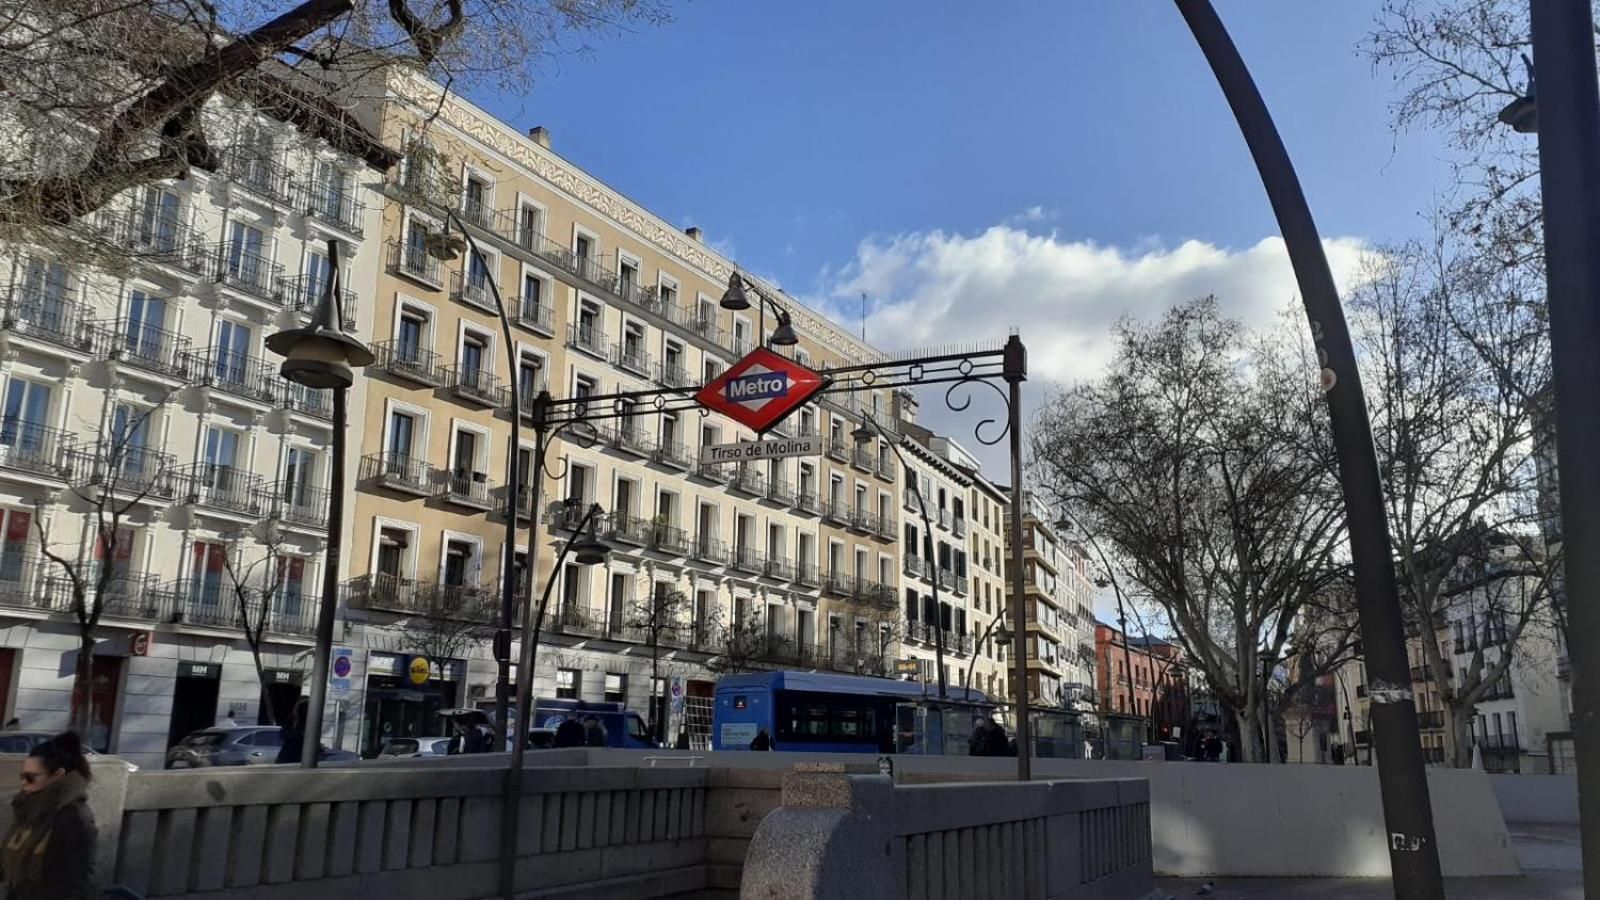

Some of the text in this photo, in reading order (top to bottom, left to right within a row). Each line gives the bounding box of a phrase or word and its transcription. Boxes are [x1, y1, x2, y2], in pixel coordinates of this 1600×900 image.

[730, 378, 783, 398] Metro
[711, 440, 811, 460] Tirso de Molina
